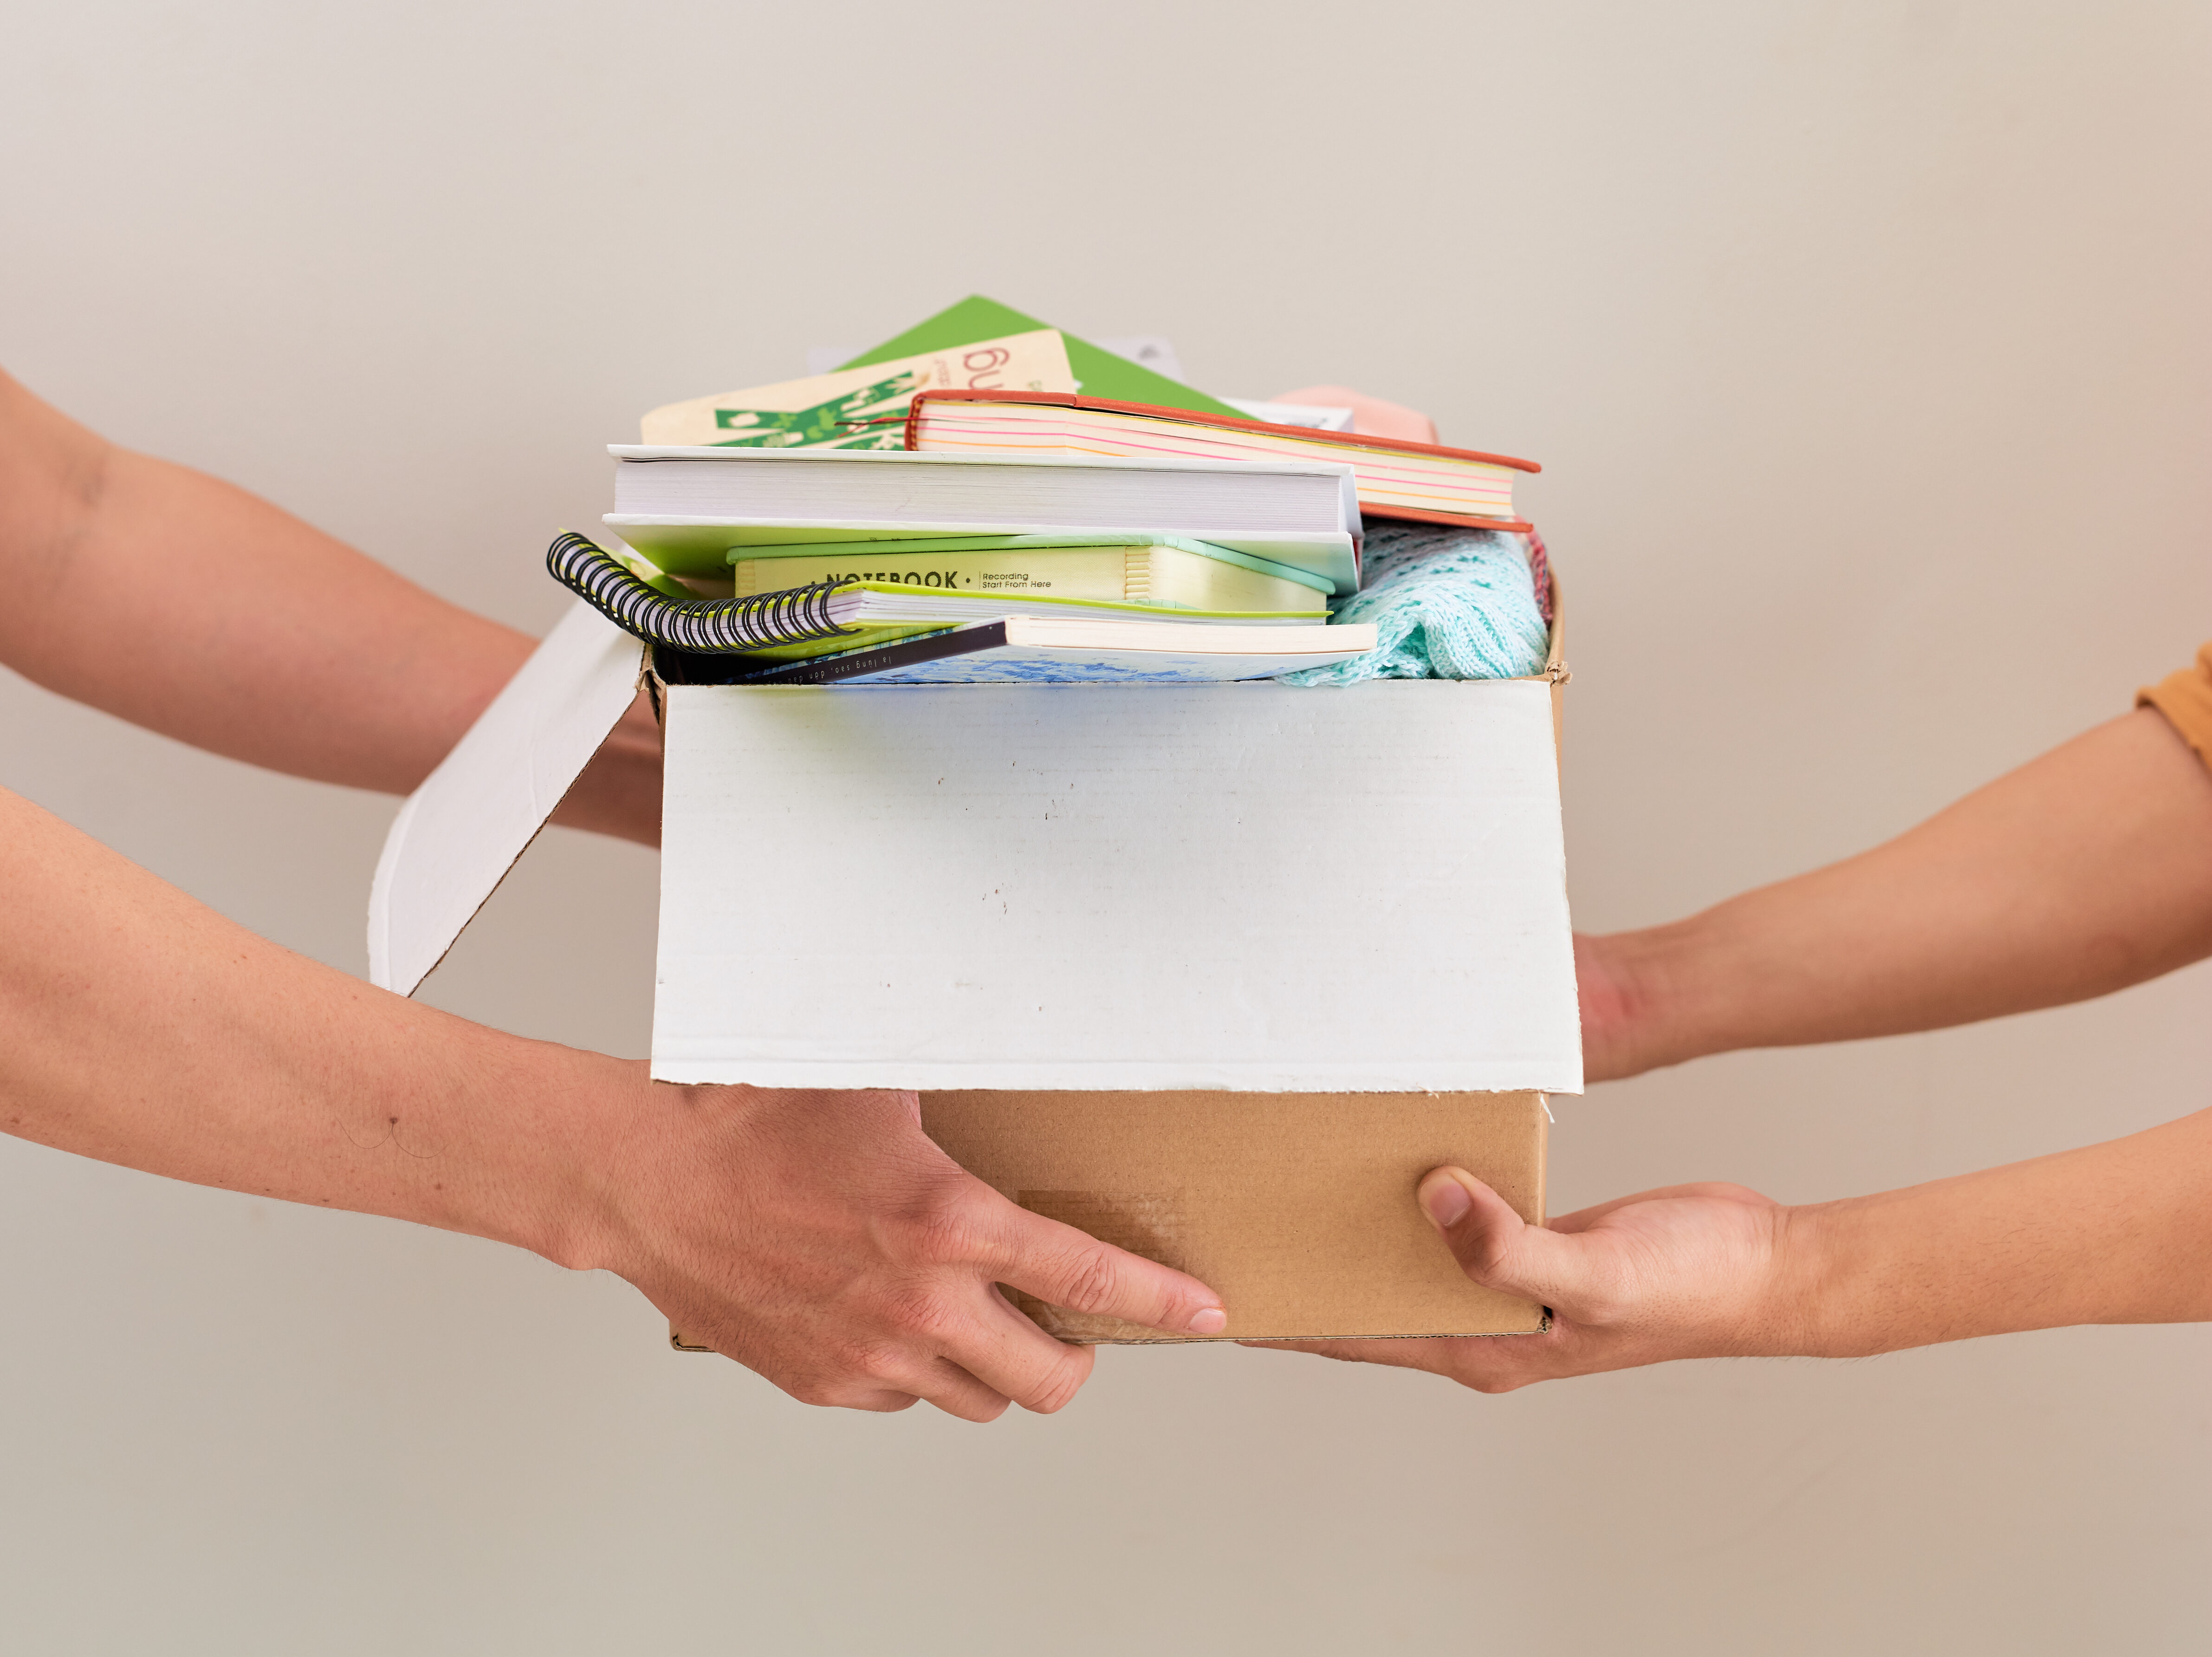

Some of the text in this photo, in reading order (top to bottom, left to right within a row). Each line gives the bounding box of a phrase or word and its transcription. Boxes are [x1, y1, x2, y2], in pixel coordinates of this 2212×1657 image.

[856, 659, 877, 668] lùng
[883, 655, 891, 664] lạ
[831, 665, 850, 673] sao,
